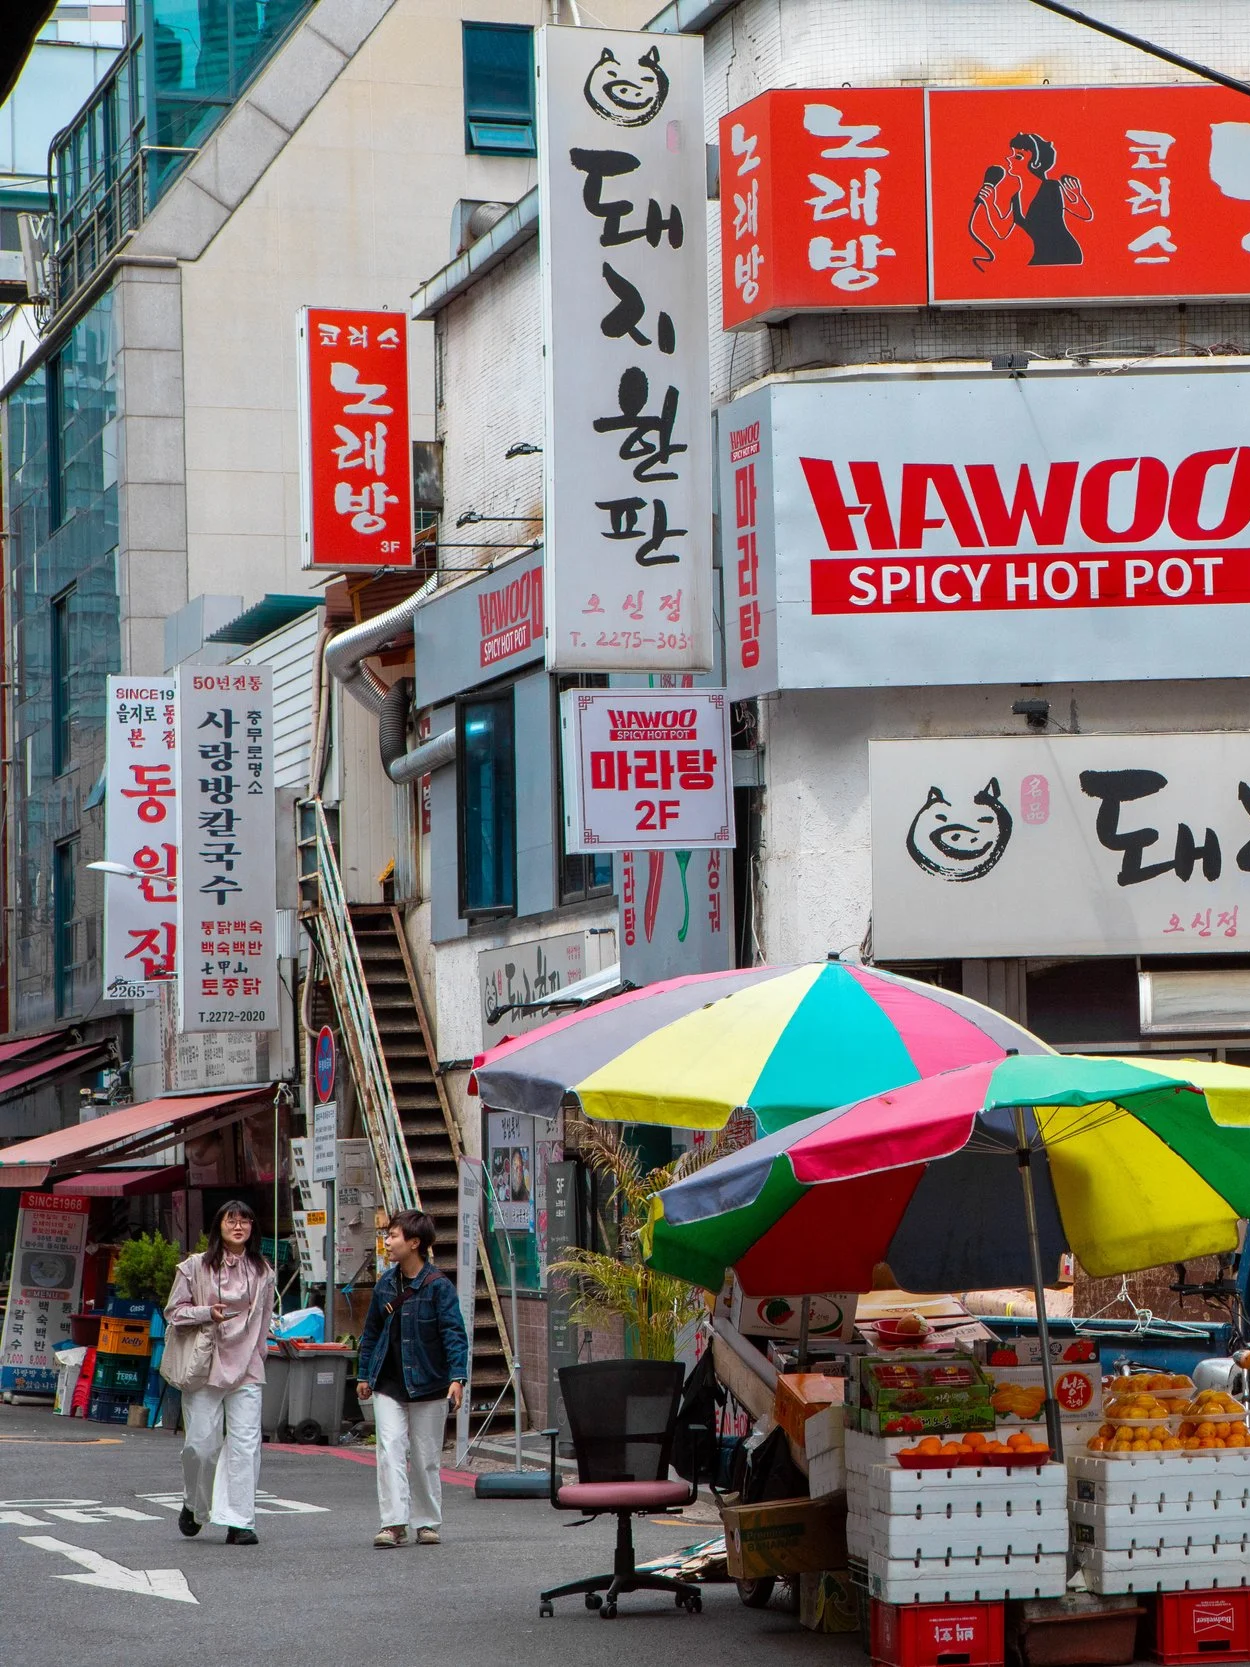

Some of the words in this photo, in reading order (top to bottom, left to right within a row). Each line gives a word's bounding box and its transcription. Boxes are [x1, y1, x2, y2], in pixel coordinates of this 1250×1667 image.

[802, 103, 897, 292] 노래방
[1125, 129, 1178, 265] 코러스
[731, 122, 764, 305] 노래방
[317, 322, 401, 349] 코러스
[329, 361, 400, 535] 노래방
[379, 540, 401, 554] 3F
[735, 462, 761, 669] 마라탕
[848, 561, 992, 607] SPICY
[1005, 558, 1109, 602] HOT
[1125, 556, 1225, 599] POT
[478, 569, 533, 638] HAWOO
[484, 638, 501, 662] SPICY
[501, 632, 514, 653] HOT
[514, 625, 527, 647] POT
[192, 675, 264, 692] 50년전통
[115, 703, 157, 725] 을지로
[607, 708, 698, 729] HAWOO
[617, 730, 646, 741] SPICY
[647, 729, 668, 741] HOT
[669, 729, 690, 740] POT
[246, 709, 264, 795] 충무로명소
[590, 747, 719, 793] 마라탕
[197, 707, 244, 906] 사랑방칼국수
[634, 799, 681, 831] 2F
[200, 919, 264, 935] 통닭백숙
[200, 940, 264, 956] 백숙백반
[200, 976, 262, 997] 토종닭
[27, 1194, 83, 1211] SINCE1968
[33, 1290, 58, 1299] MENU
[10, 1309, 26, 1351] 칼국수
[33, 1301, 50, 1353] 백숙백반
[121, 1336, 144, 1348] Kelly
[116, 1370, 138, 1382] TERRA
[1061, 1375, 1087, 1398] 성주
[1195, 1615, 1233, 1625] Budweiser
